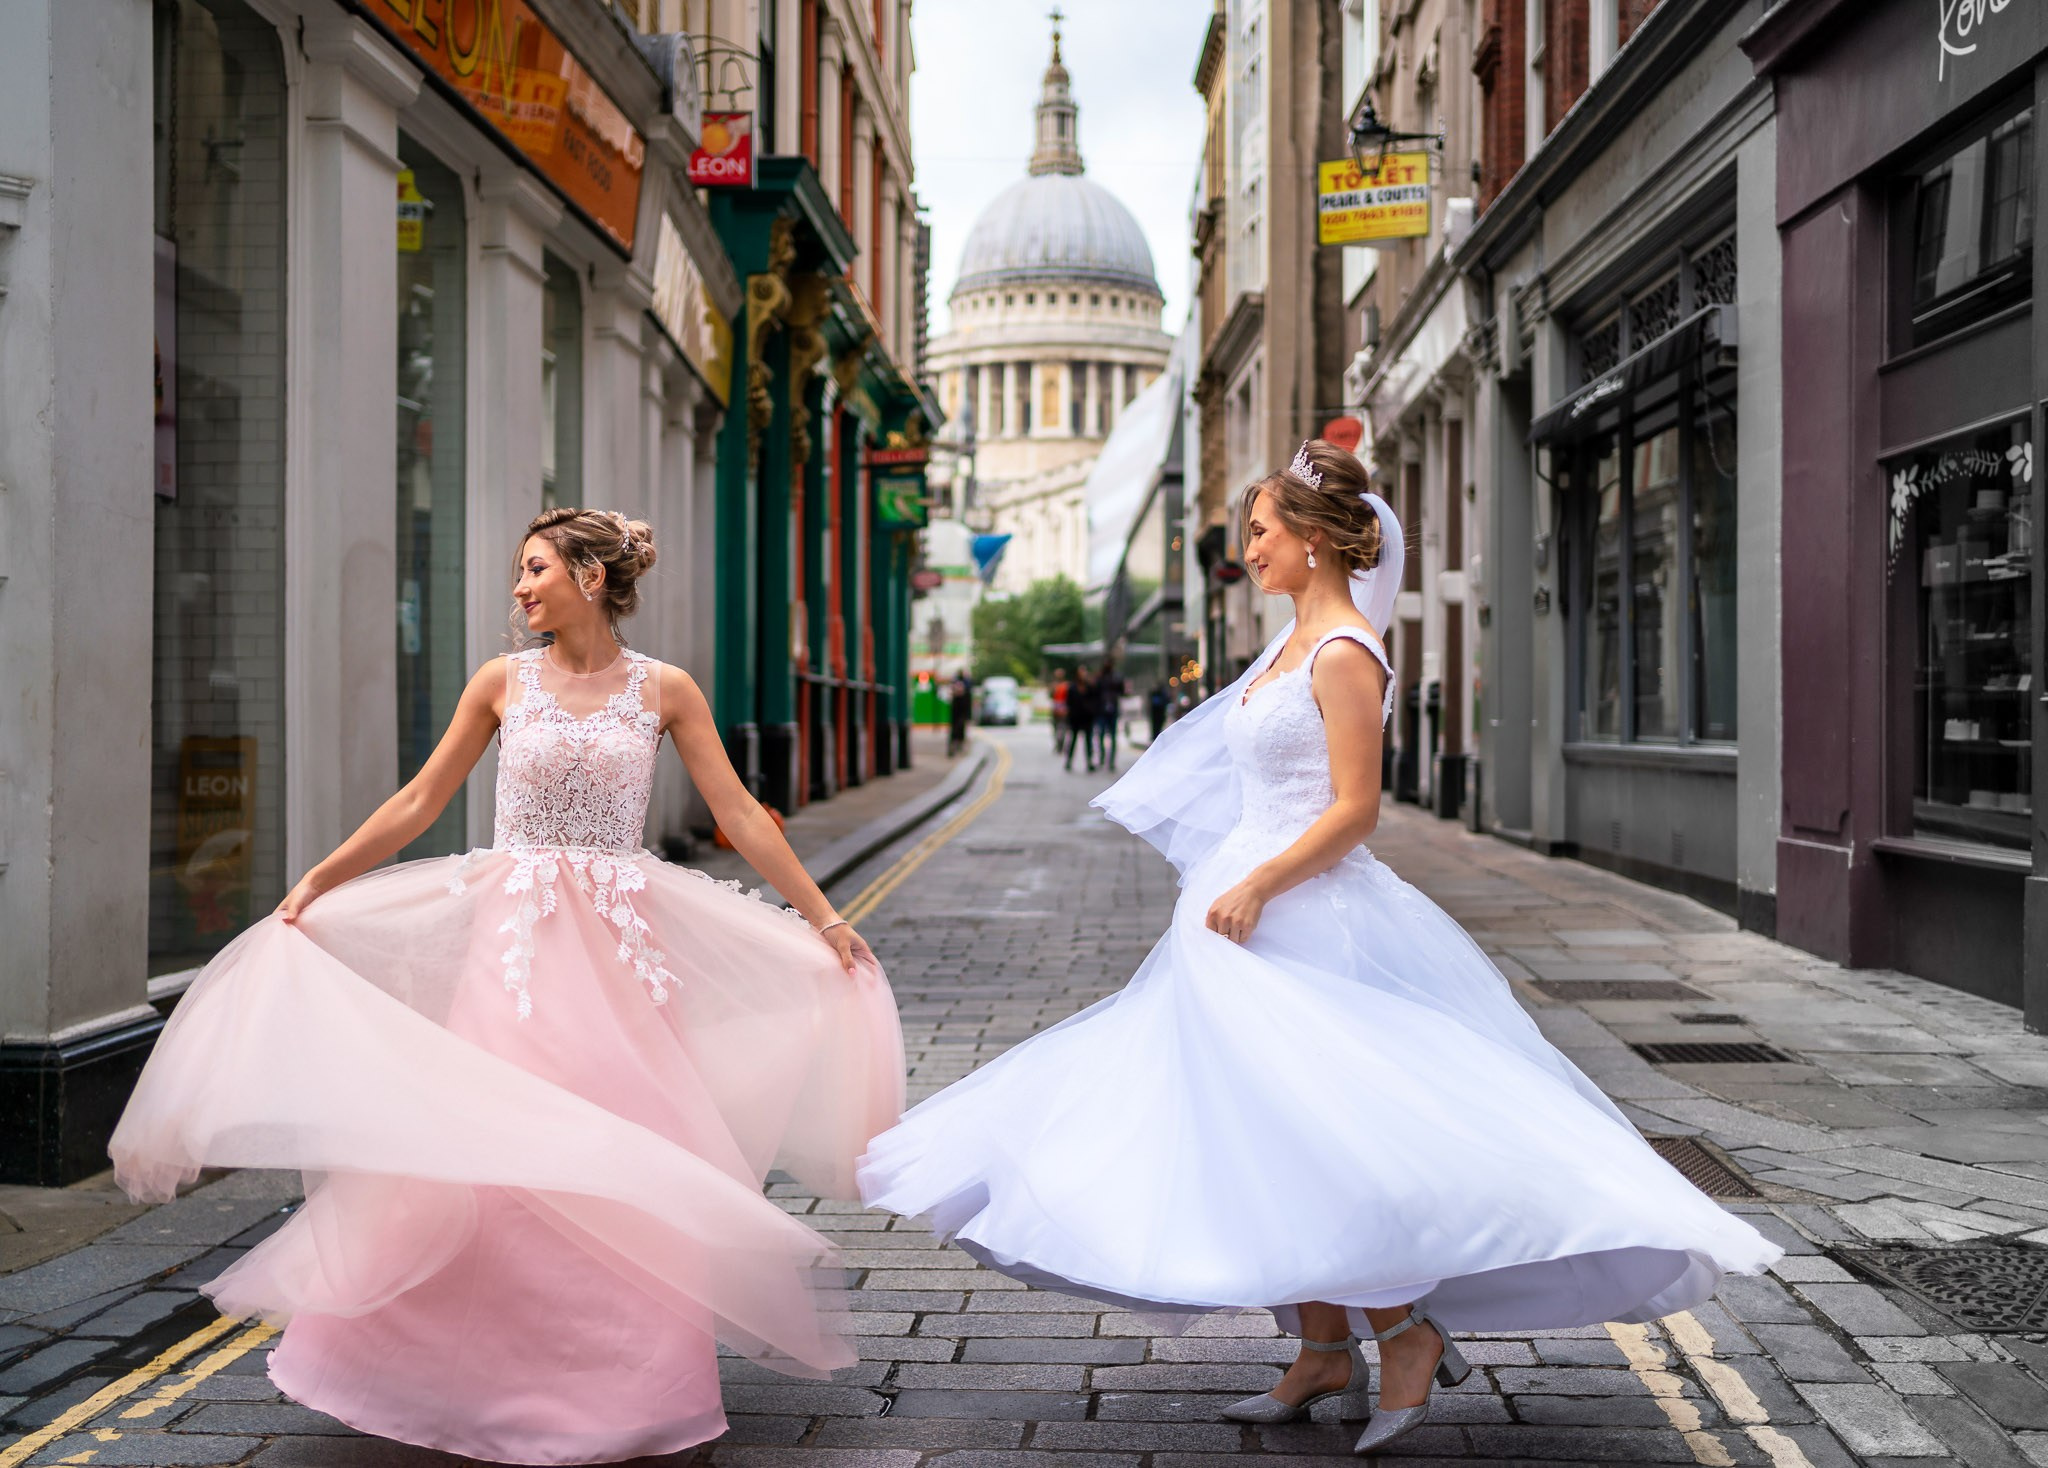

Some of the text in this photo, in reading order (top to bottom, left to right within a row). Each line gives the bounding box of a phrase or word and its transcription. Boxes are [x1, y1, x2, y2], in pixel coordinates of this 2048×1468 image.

[686, 157, 747, 177] LEON
[1329, 165, 1416, 190] TO LET
[1320, 186, 1425, 210] PEARL & COUTTS
[186, 775, 249, 796] LEON
